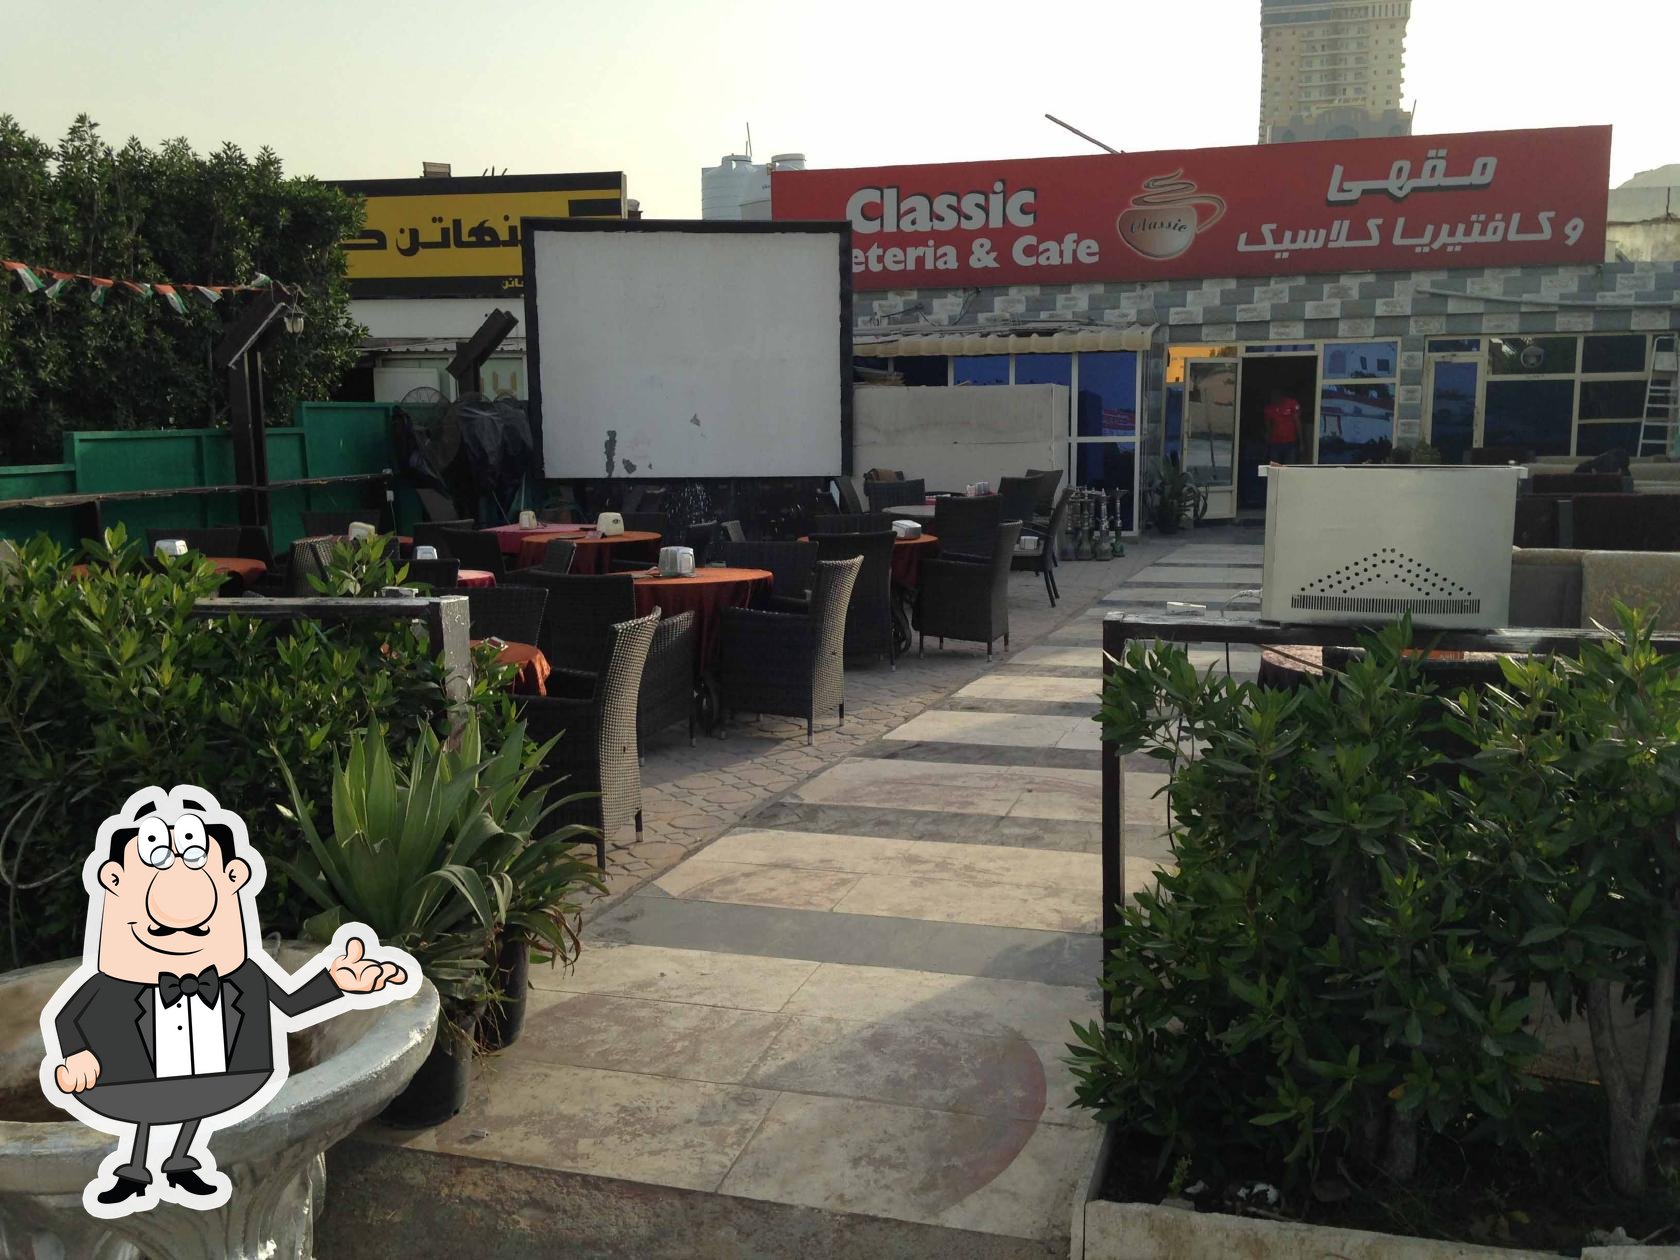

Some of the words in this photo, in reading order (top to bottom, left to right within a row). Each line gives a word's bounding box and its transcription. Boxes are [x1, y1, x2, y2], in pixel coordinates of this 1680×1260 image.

[1327, 149, 1497, 203] مقهى
[846, 180, 1037, 234] Classic
[395, 214, 521, 256] نهاتن
[852, 239, 959, 273] eteria
[968, 237, 1000, 268] &
[1012, 233, 1100, 266] Cafe
